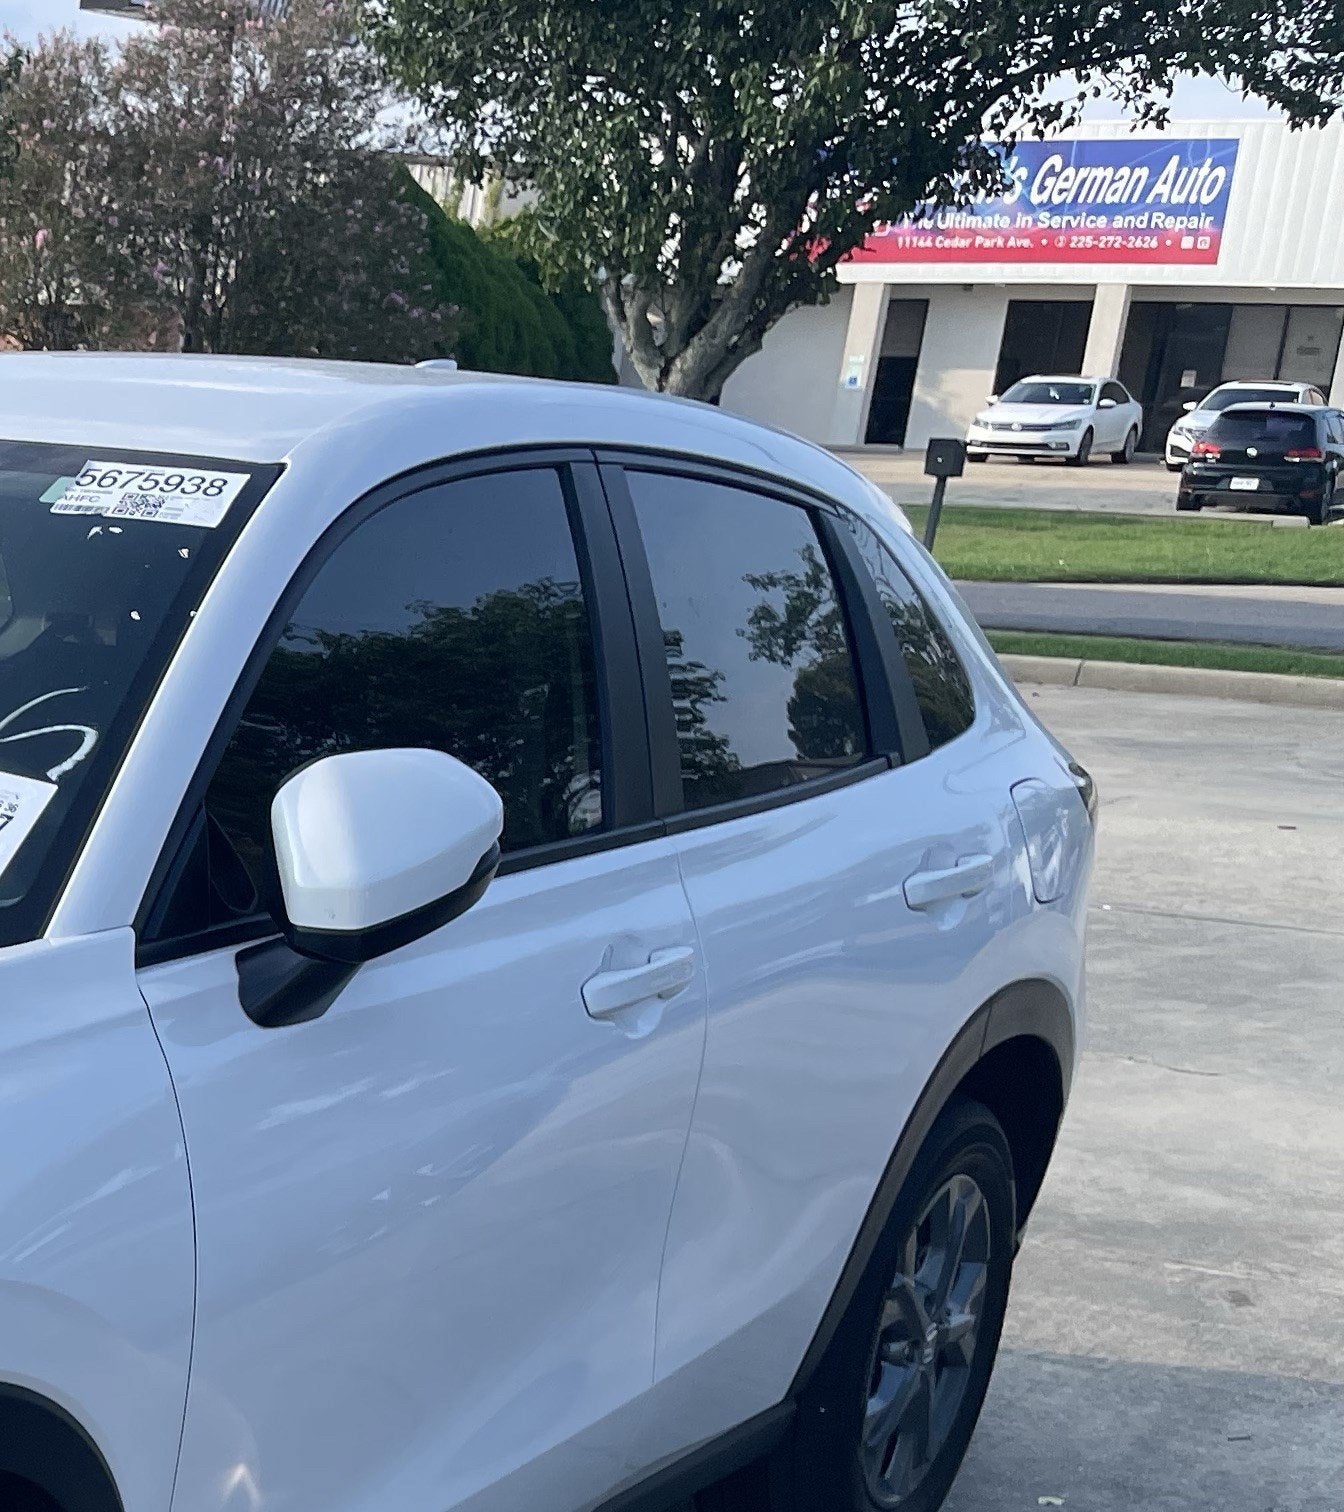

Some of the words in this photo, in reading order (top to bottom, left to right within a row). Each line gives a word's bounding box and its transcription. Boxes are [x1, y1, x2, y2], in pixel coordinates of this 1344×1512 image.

[1029, 153, 1150, 206] German
[1146, 154, 1227, 206] Auto
[937, 211, 1011, 230] Ultimate
[1015, 211, 1033, 229] in
[1037, 211, 1107, 230] Service
[1112, 211, 1149, 229] and
[1151, 211, 1214, 232] Repair
[935, 235, 973, 249] Cedar
[975, 235, 1004, 249] Park
[75, 468, 229, 497] 5675938
